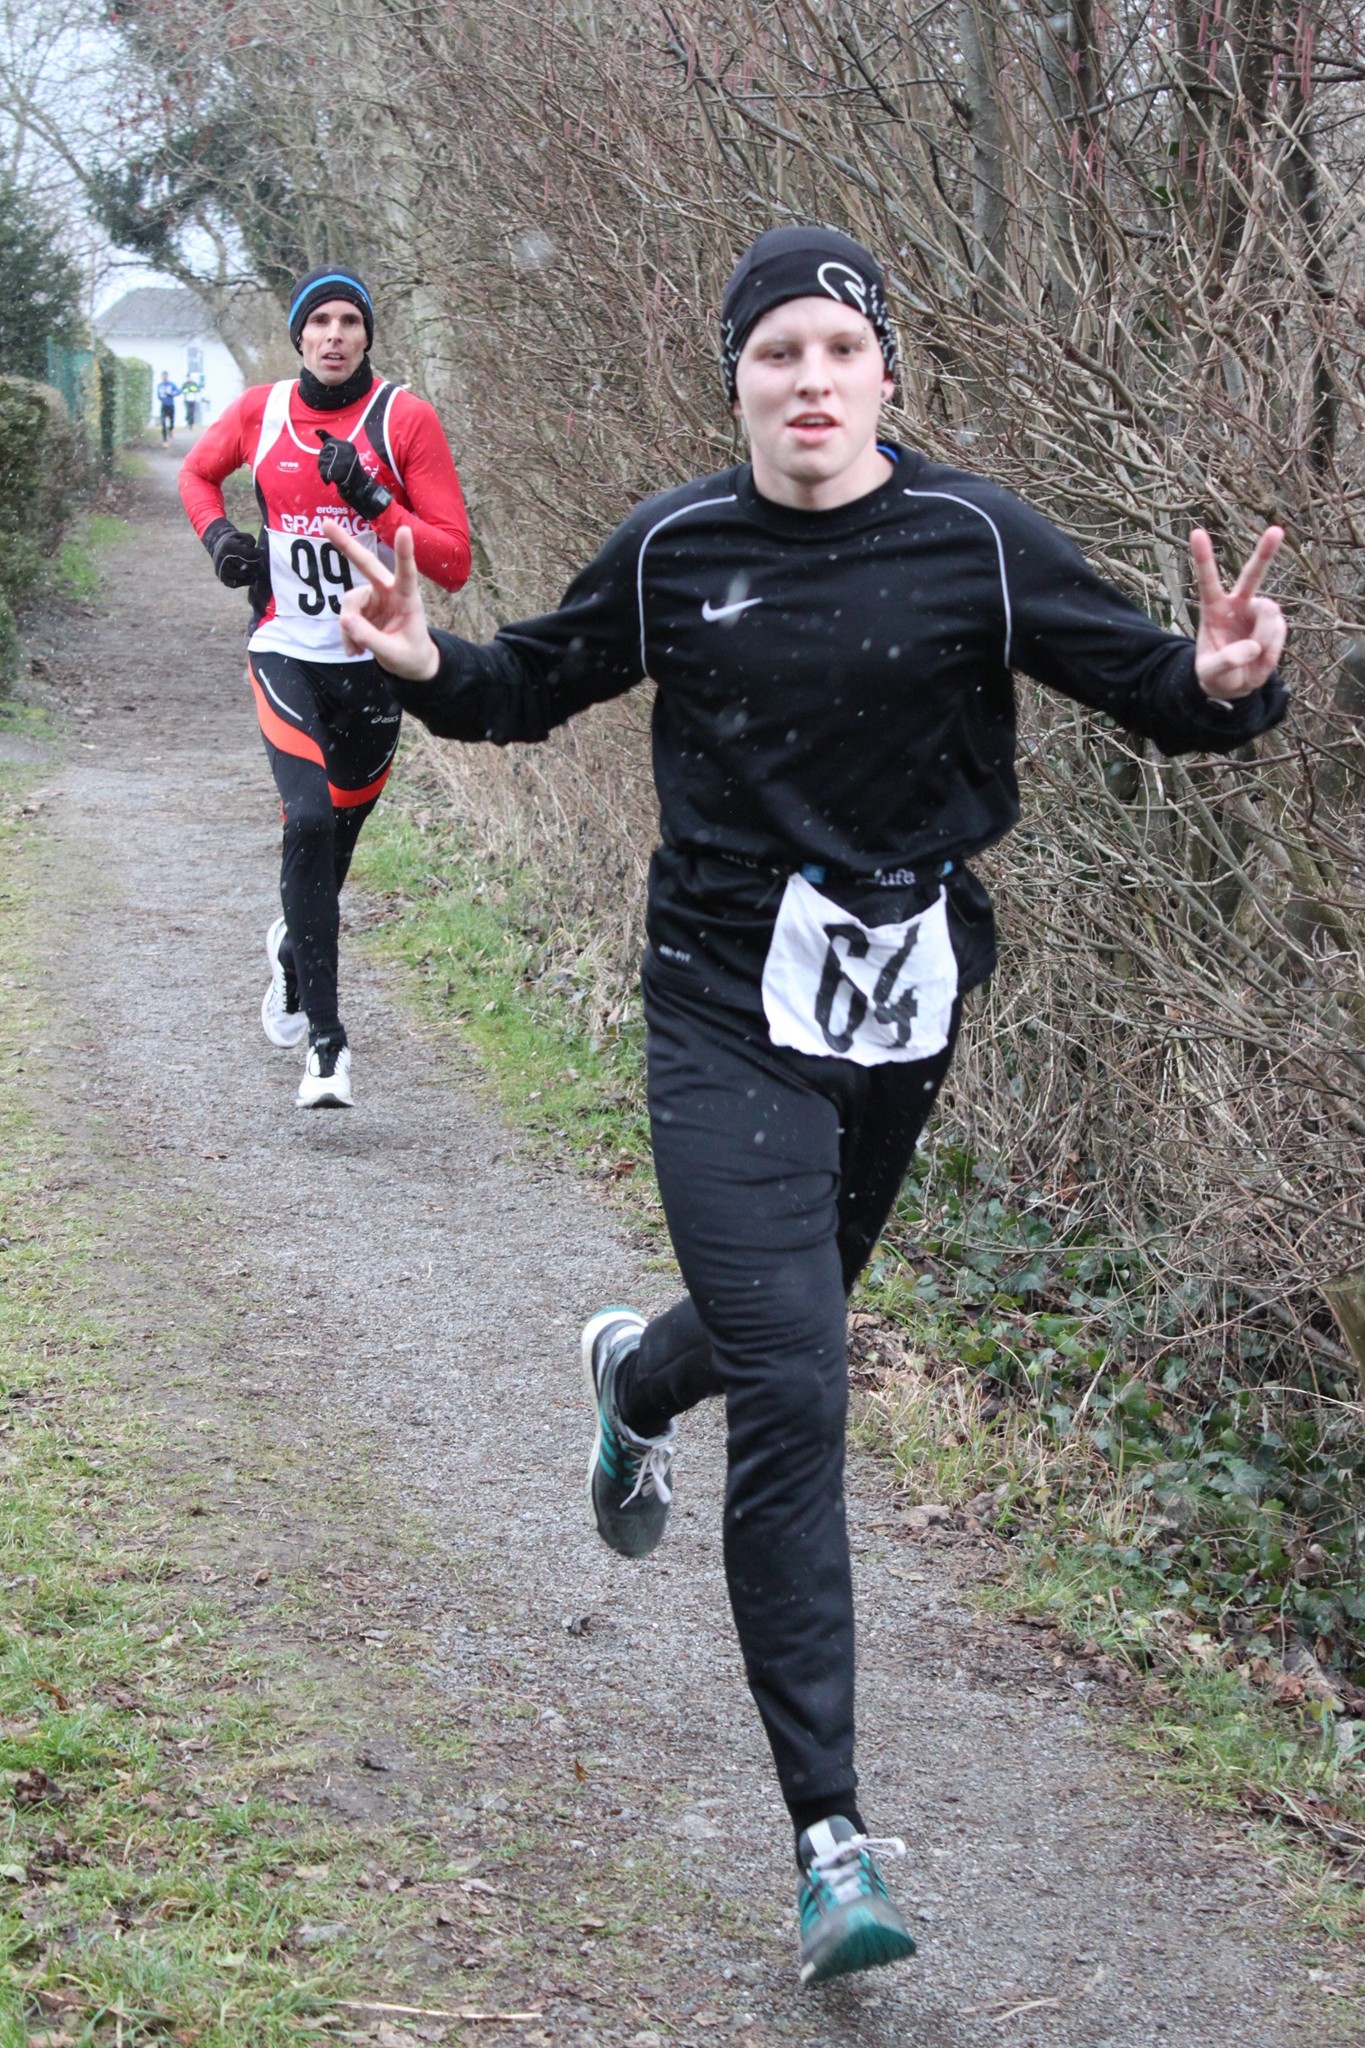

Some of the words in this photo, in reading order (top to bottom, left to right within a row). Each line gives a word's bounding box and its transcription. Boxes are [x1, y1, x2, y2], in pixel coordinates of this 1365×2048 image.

[316, 505, 349, 515] erdgas
[290, 539, 354, 616] 99
[815, 922, 921, 1054] 64
